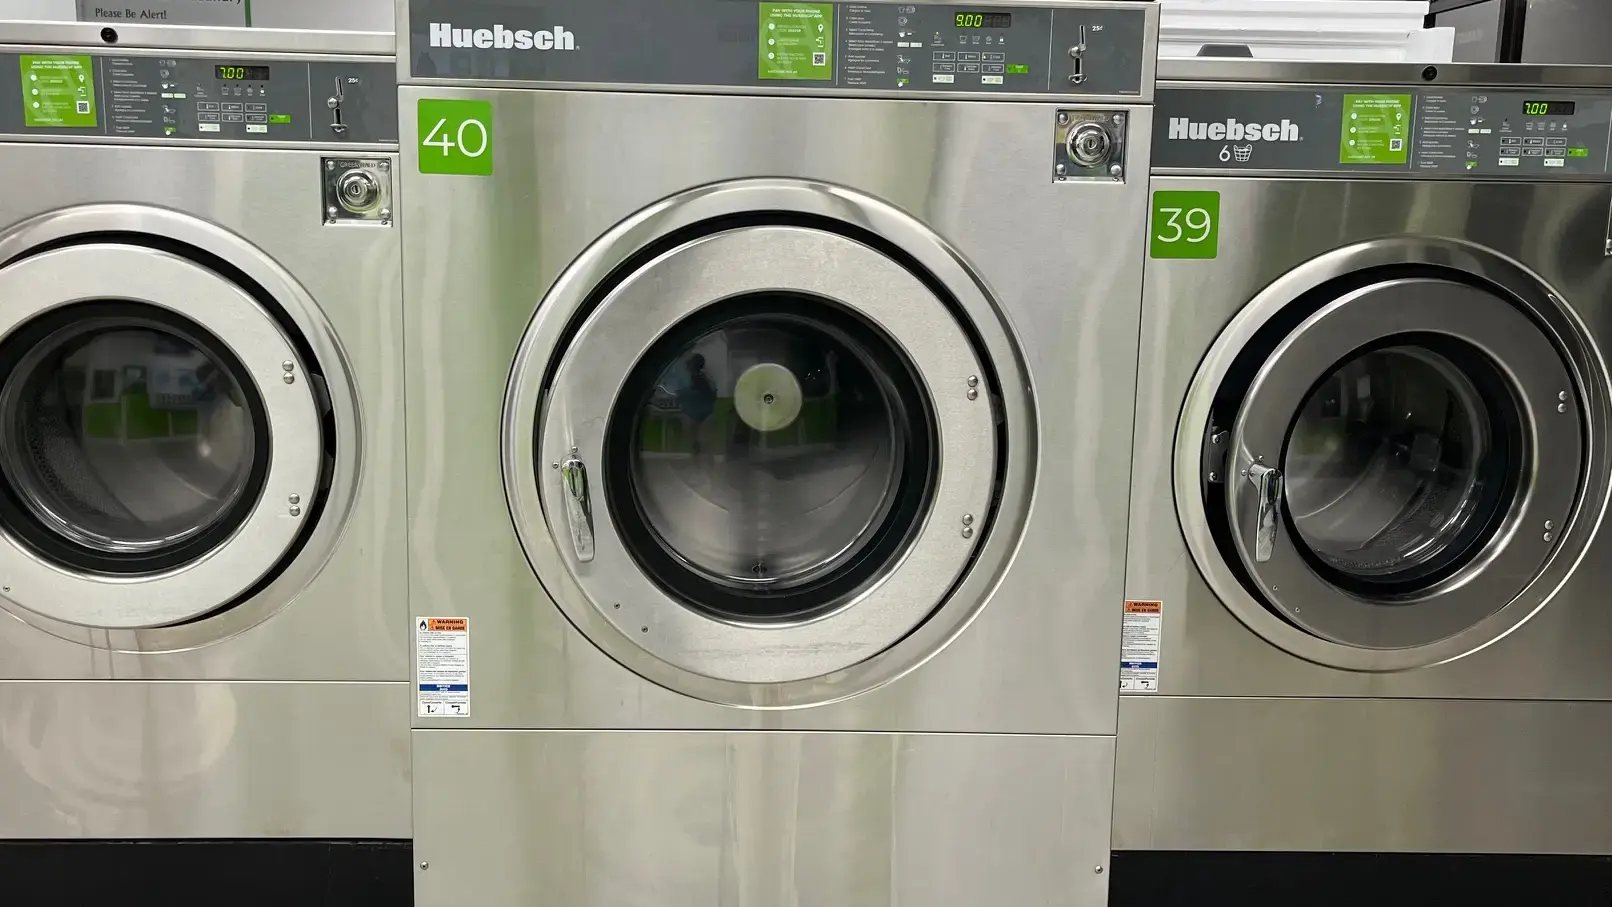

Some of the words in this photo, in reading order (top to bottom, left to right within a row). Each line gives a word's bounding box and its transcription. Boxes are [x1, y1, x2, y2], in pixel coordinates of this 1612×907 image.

[95, 8, 122, 18] Please
[125, 9, 136, 18] Be
[140, 9, 167, 20] Alert!
[956, 14, 983, 27] 9.00
[429, 22, 574, 50] Huebsch
[1525, 102, 1548, 114] 7.00
[422, 118, 487, 157] 40
[1168, 117, 1299, 142] Huebsch
[1219, 145, 1230, 162] 6
[1157, 207, 1211, 243] 39
